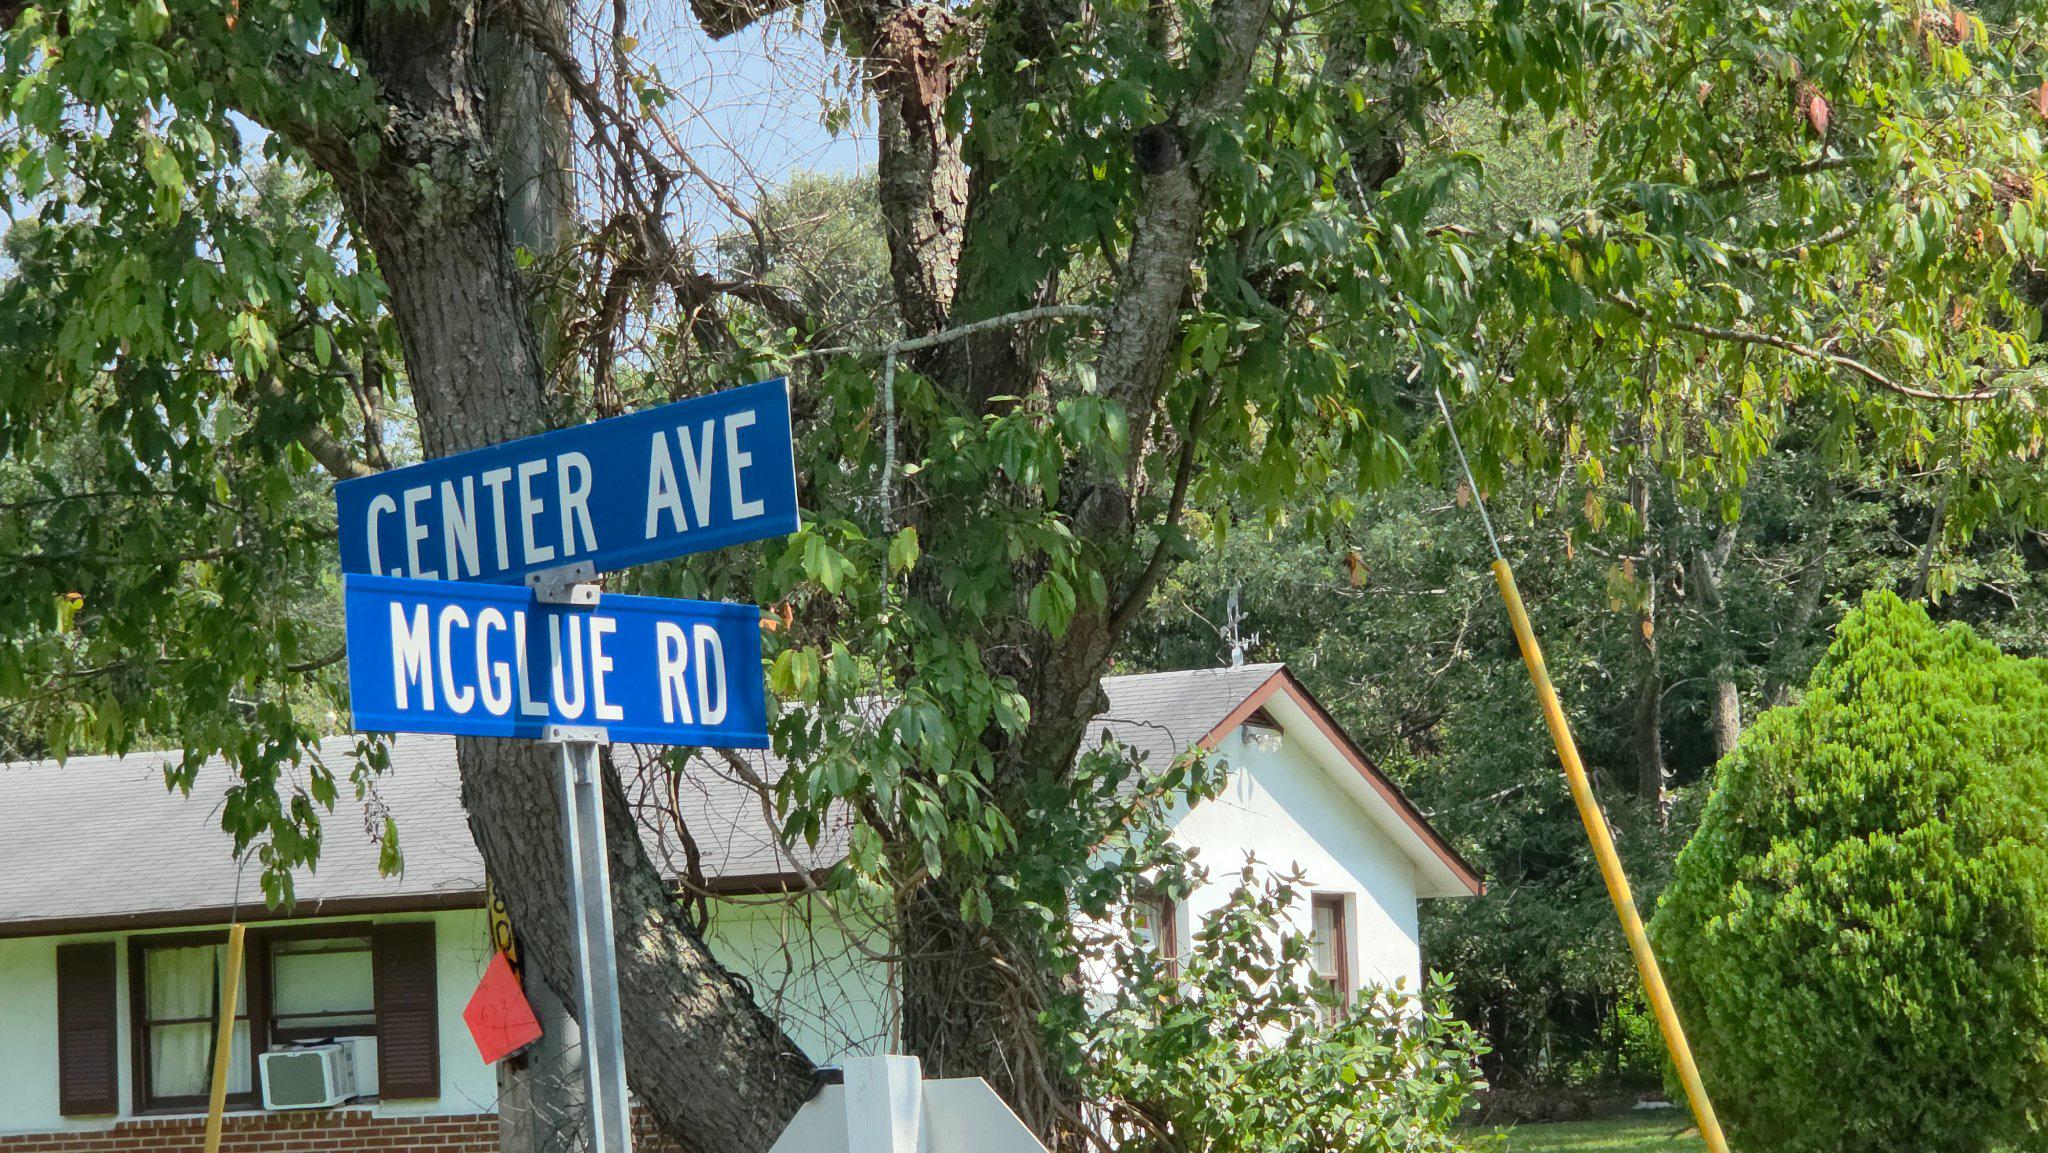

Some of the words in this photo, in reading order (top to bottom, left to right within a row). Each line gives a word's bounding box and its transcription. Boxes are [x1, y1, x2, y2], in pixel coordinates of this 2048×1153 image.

[367, 452, 598, 581] CENTER
[645, 409, 765, 540] AVE
[389, 602, 624, 721] MCGLUE
[656, 621, 728, 726] RD
